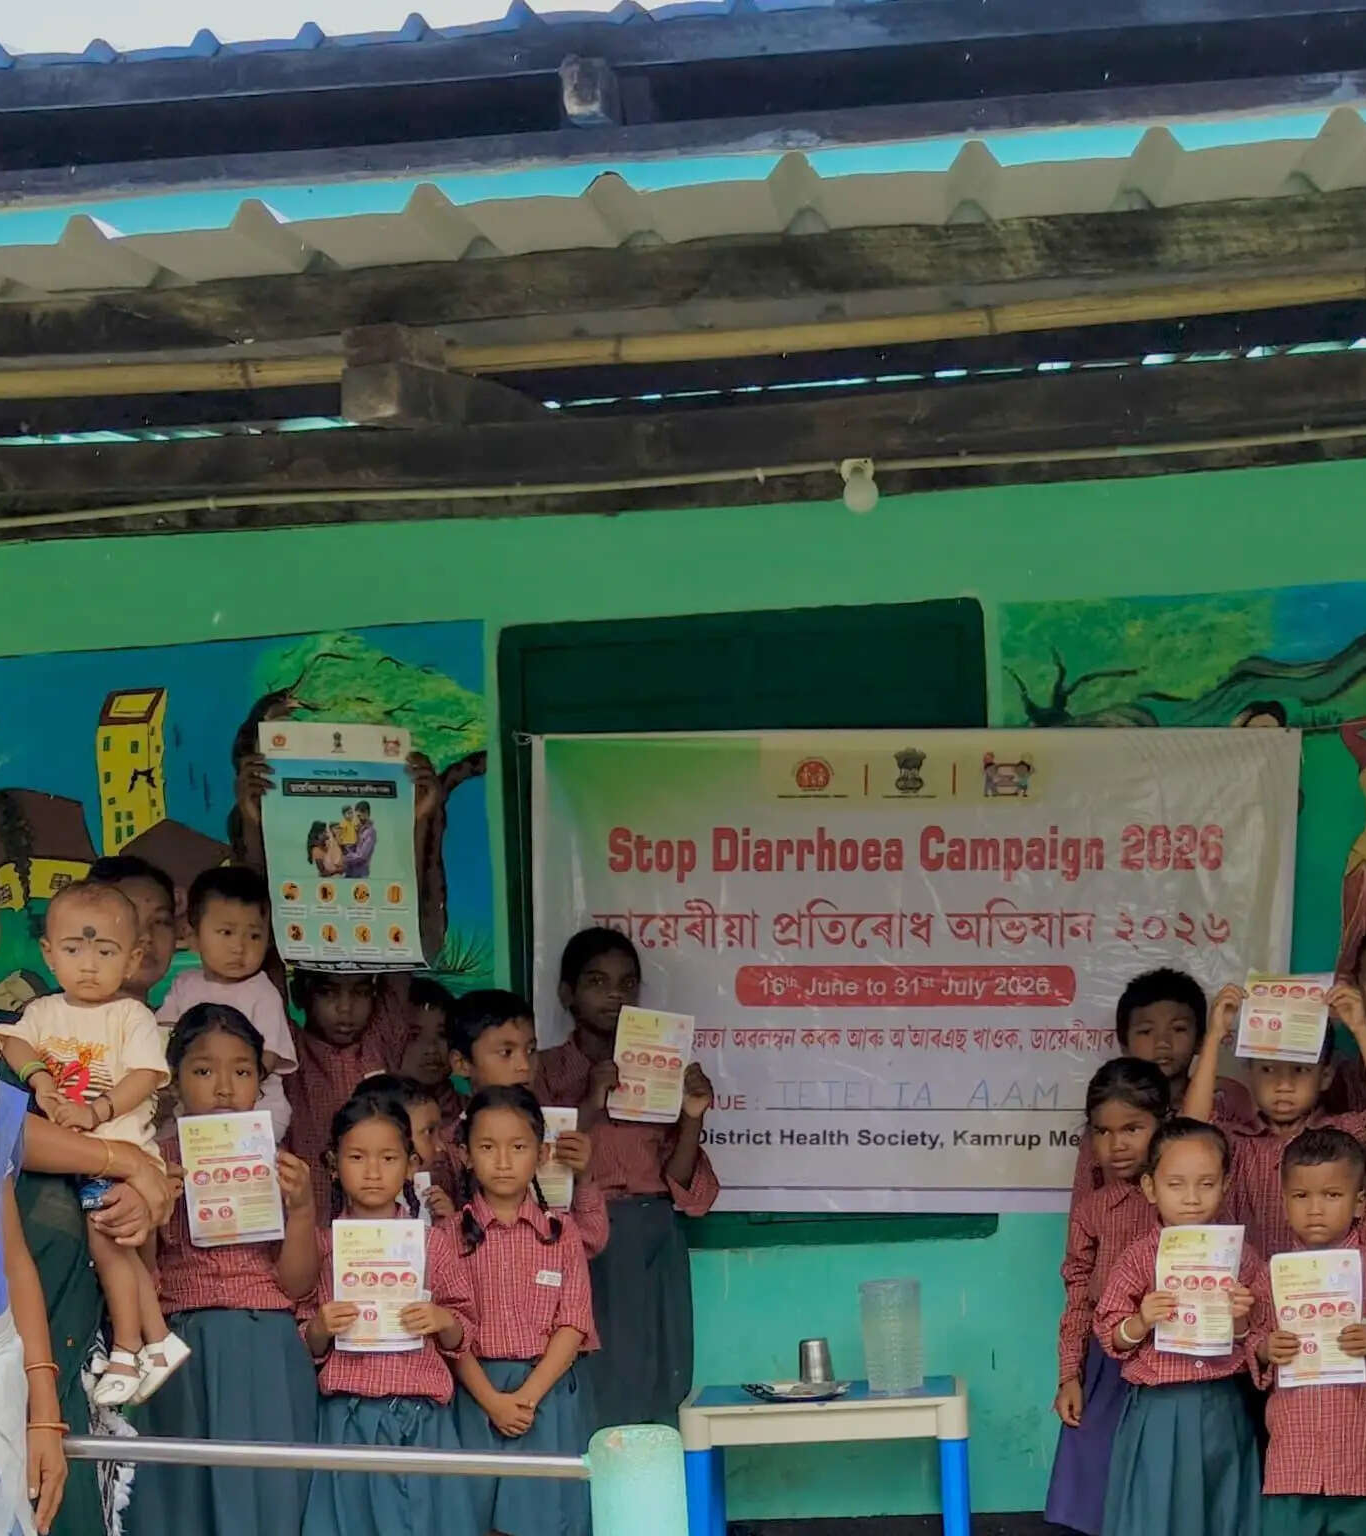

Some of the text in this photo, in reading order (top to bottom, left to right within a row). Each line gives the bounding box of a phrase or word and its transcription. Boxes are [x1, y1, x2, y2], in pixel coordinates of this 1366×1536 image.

[608, 824, 1225, 883] Stop Diarrhoea Campaign 2026
[1115, 911, 1231, 949] ২০২৬
[805, 977, 860, 996] June
[866, 977, 886, 996] to
[894, 976, 935, 996] 31st
[941, 977, 986, 1000] July
[699, 1128, 772, 1146] District
[779, 1128, 849, 1146] Health
[857, 1129, 945, 1150] Society,
[953, 1130, 1041, 1152] Kamrup
